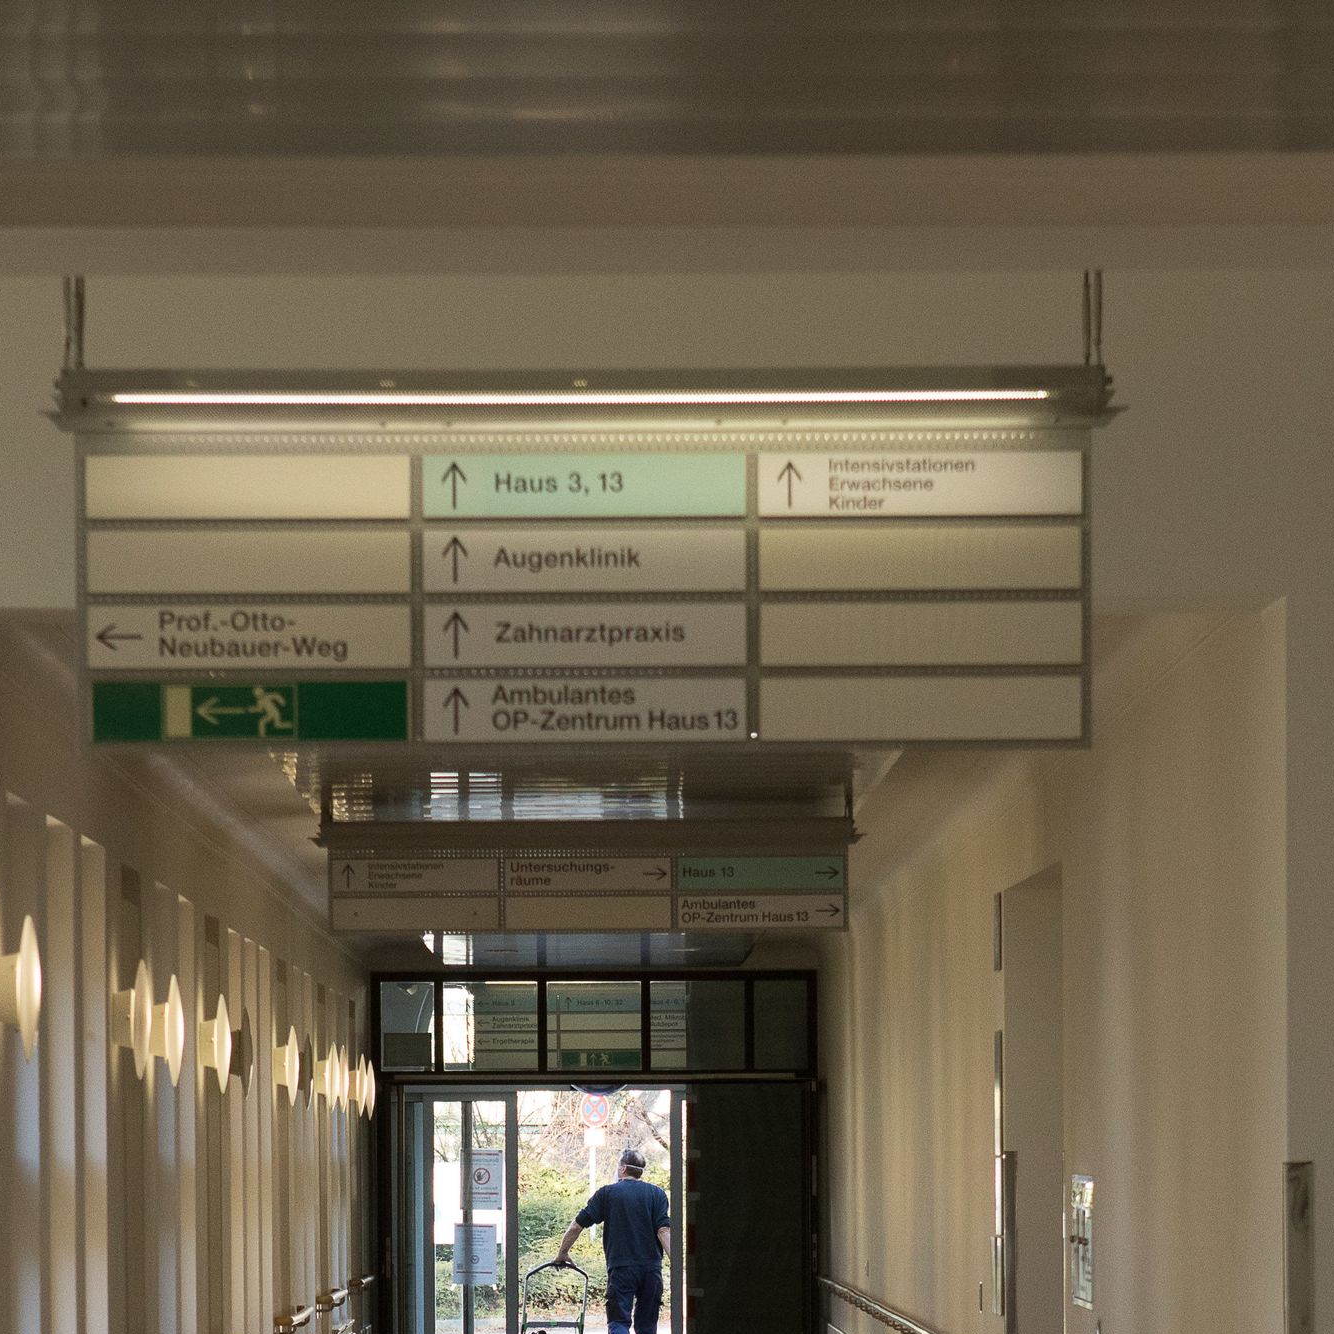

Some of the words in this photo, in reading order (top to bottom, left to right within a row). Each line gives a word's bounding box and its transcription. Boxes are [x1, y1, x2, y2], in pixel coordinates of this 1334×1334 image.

[828, 457, 976, 474] Intensivstationen
[494, 471, 558, 494] Haus
[568, 472, 590, 496] 3,
[599, 471, 624, 493] 13
[828, 475, 934, 492] Erwachsene
[828, 495, 885, 511] Kinder
[493, 547, 641, 574] Augenklinik
[158, 609, 297, 632] Prof.-Otto-
[495, 621, 686, 647] Zahnarztpraxis
[158, 636, 348, 663] Neubauer-Weg
[491, 683, 636, 705] Ambulantes
[491, 709, 641, 731] OP-Zentrum
[648, 708, 710, 730] Haus
[713, 708, 739, 730] 13
[509, 861, 616, 876] Untersuchungs-
[682, 867, 716, 878] Haus
[721, 866, 735, 878] 13
[368, 881, 398, 890] Kinder
[509, 874, 552, 887] räume
[681, 899, 756, 911] Ambulantes
[681, 911, 759, 924] OP-Zentrum
[762, 911, 794, 923] Haus
[796, 911, 810, 923] 13
